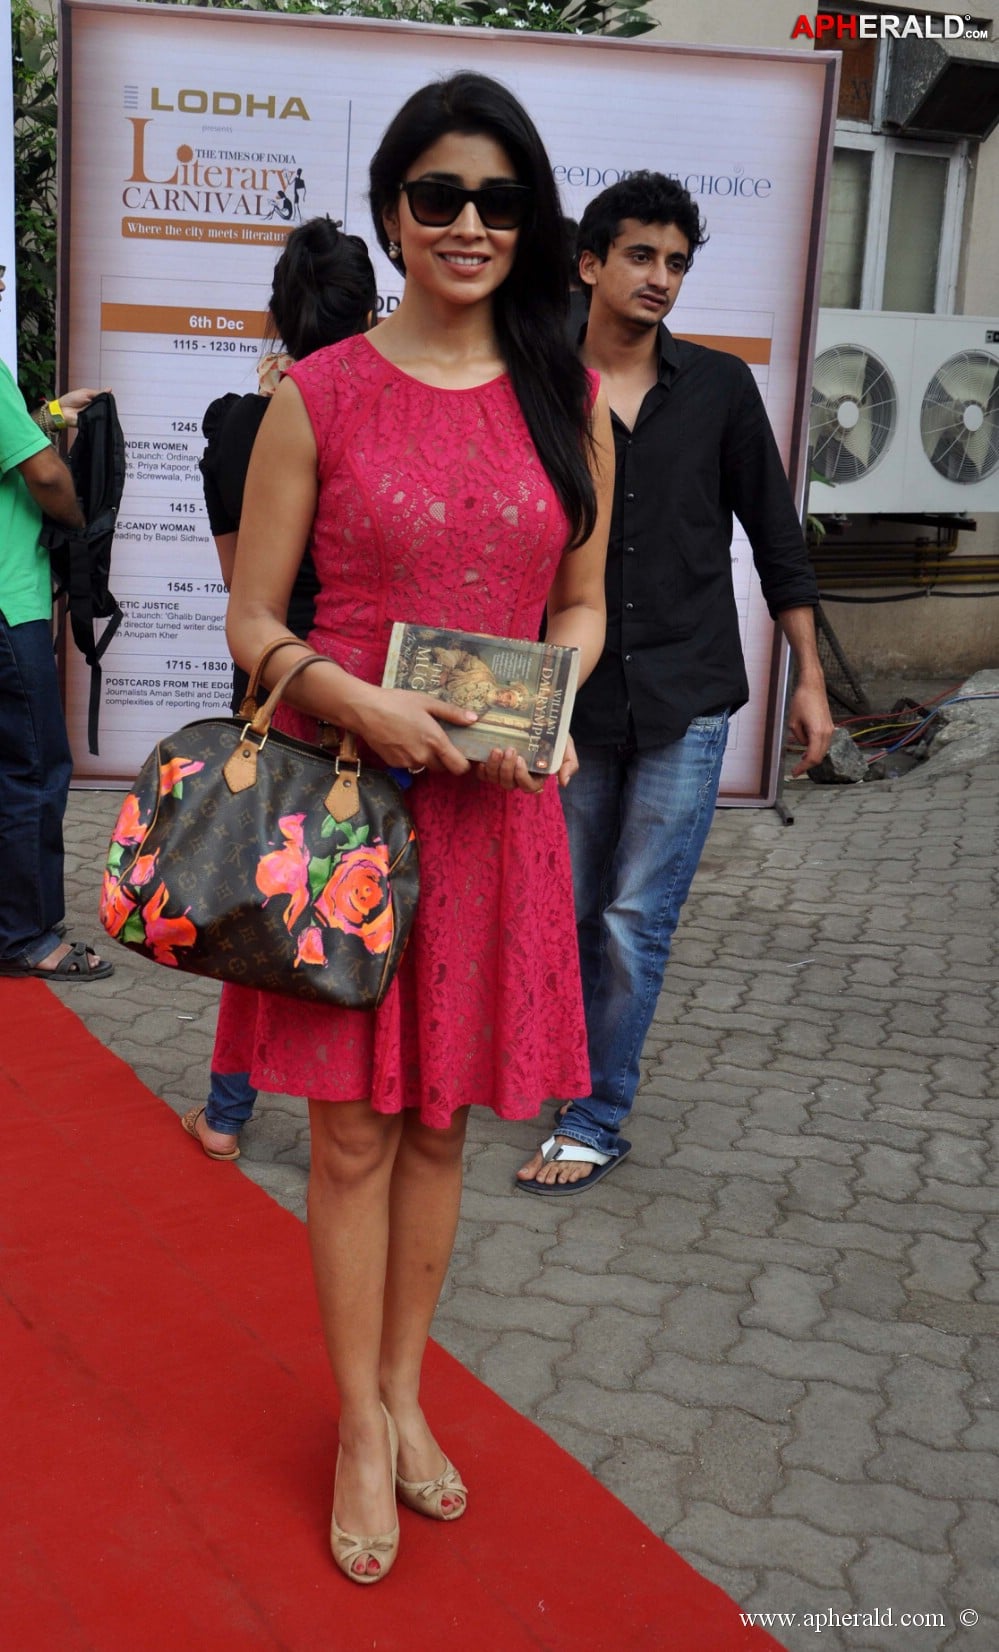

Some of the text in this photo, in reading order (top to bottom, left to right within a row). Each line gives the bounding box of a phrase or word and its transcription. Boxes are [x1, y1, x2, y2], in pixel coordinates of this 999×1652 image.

[151, 87, 312, 121] LODHA
[124, 117, 296, 193] Literary
[195, 148, 296, 164] THE TIMES OF INDIA
[122, 186, 270, 216] CARNIVAL
[127, 222, 290, 242] Where the city meets literatur
[189, 315, 244, 331] 6th Dec
[173, 339, 198, 350] 1115
[210, 341, 236, 352] 1230
[239, 342, 258, 353] hrs
[171, 421, 198, 432] 1245
[124, 441, 188, 451] NDER WOMEN
[166, 453, 202, 463] Ordinary
[138, 461, 159, 470] Priya
[169, 502, 197, 513] 1415
[160, 523, 196, 532] WOMAN
[114, 532, 141, 541] eading
[143, 533, 153, 542] by
[180, 534, 210, 543] Sidhwa
[167, 582, 193, 592] 1545
[116, 600, 179, 610] ETIC JUSTICE
[124, 621, 153, 629] director
[156, 622, 181, 630] turned
[123, 630, 157, 639] Anupam
[159, 631, 178, 639] Kher
[166, 660, 191, 670] 1715
[202, 661, 228, 671] 1830
[411, 646, 432, 690] MUG
[105, 678, 161, 687] POSTCARDS
[163, 679, 189, 688] FROM
[191, 680, 209, 688] THE
[106, 687, 232, 699] Journalists Aman Sethi and Decl
[105, 697, 154, 706] complexities
[156, 698, 164, 706] of
[165, 699, 200, 709] reporting
[202, 700, 220, 708] from
[527, 667, 554, 753] DALRYMPLE
[546, 689, 563, 736] WILLIAM
